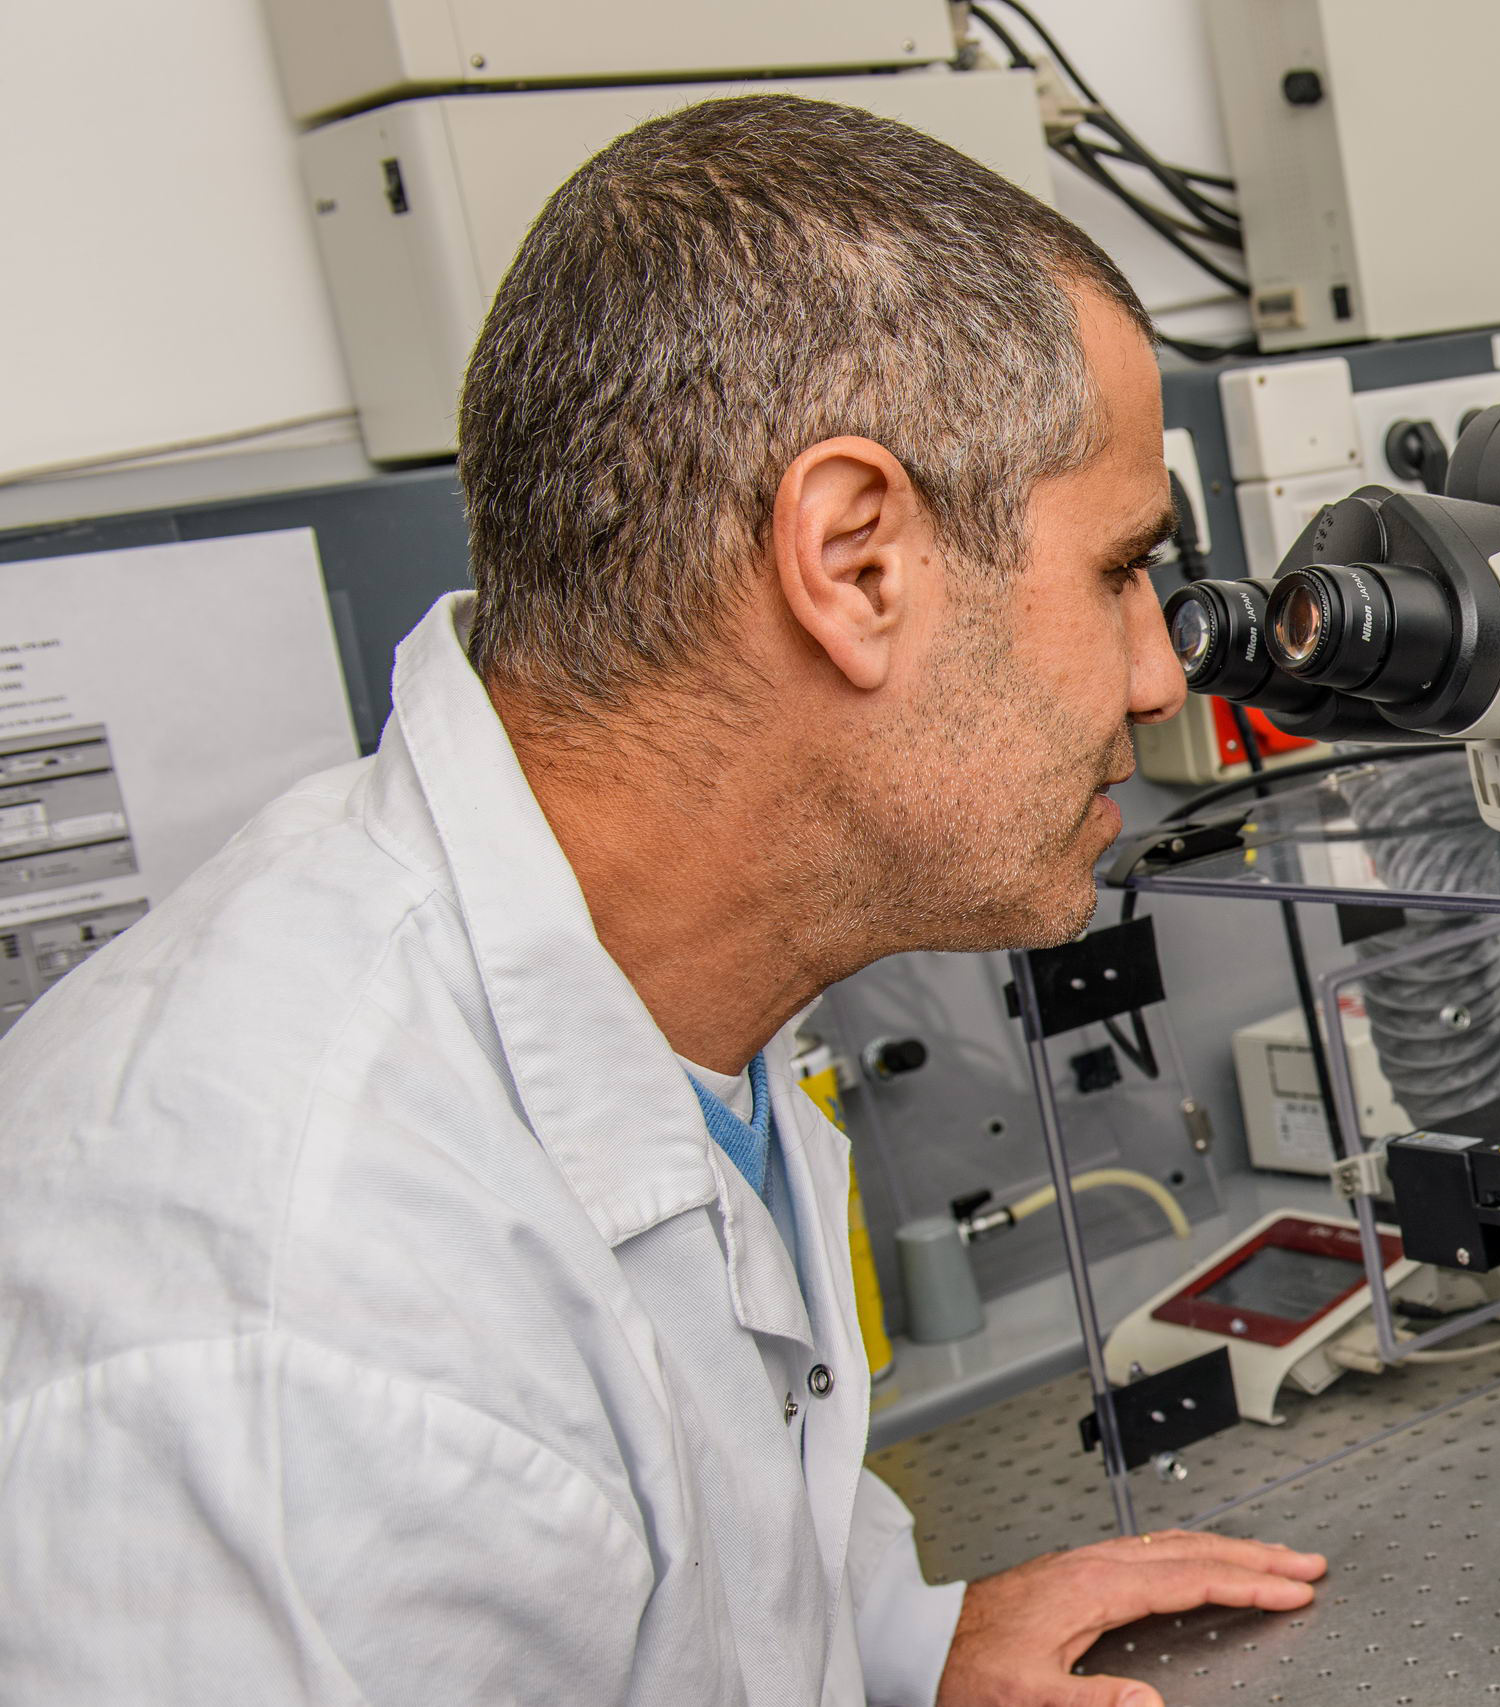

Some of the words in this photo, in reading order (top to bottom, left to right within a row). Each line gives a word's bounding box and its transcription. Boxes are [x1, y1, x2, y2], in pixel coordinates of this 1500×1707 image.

[1349, 572, 1371, 601] JAPAN
[1239, 592, 1257, 622] JAPAN
[1361, 604, 1372, 642] Nikon
[1245, 627, 1258, 662] Nikon
